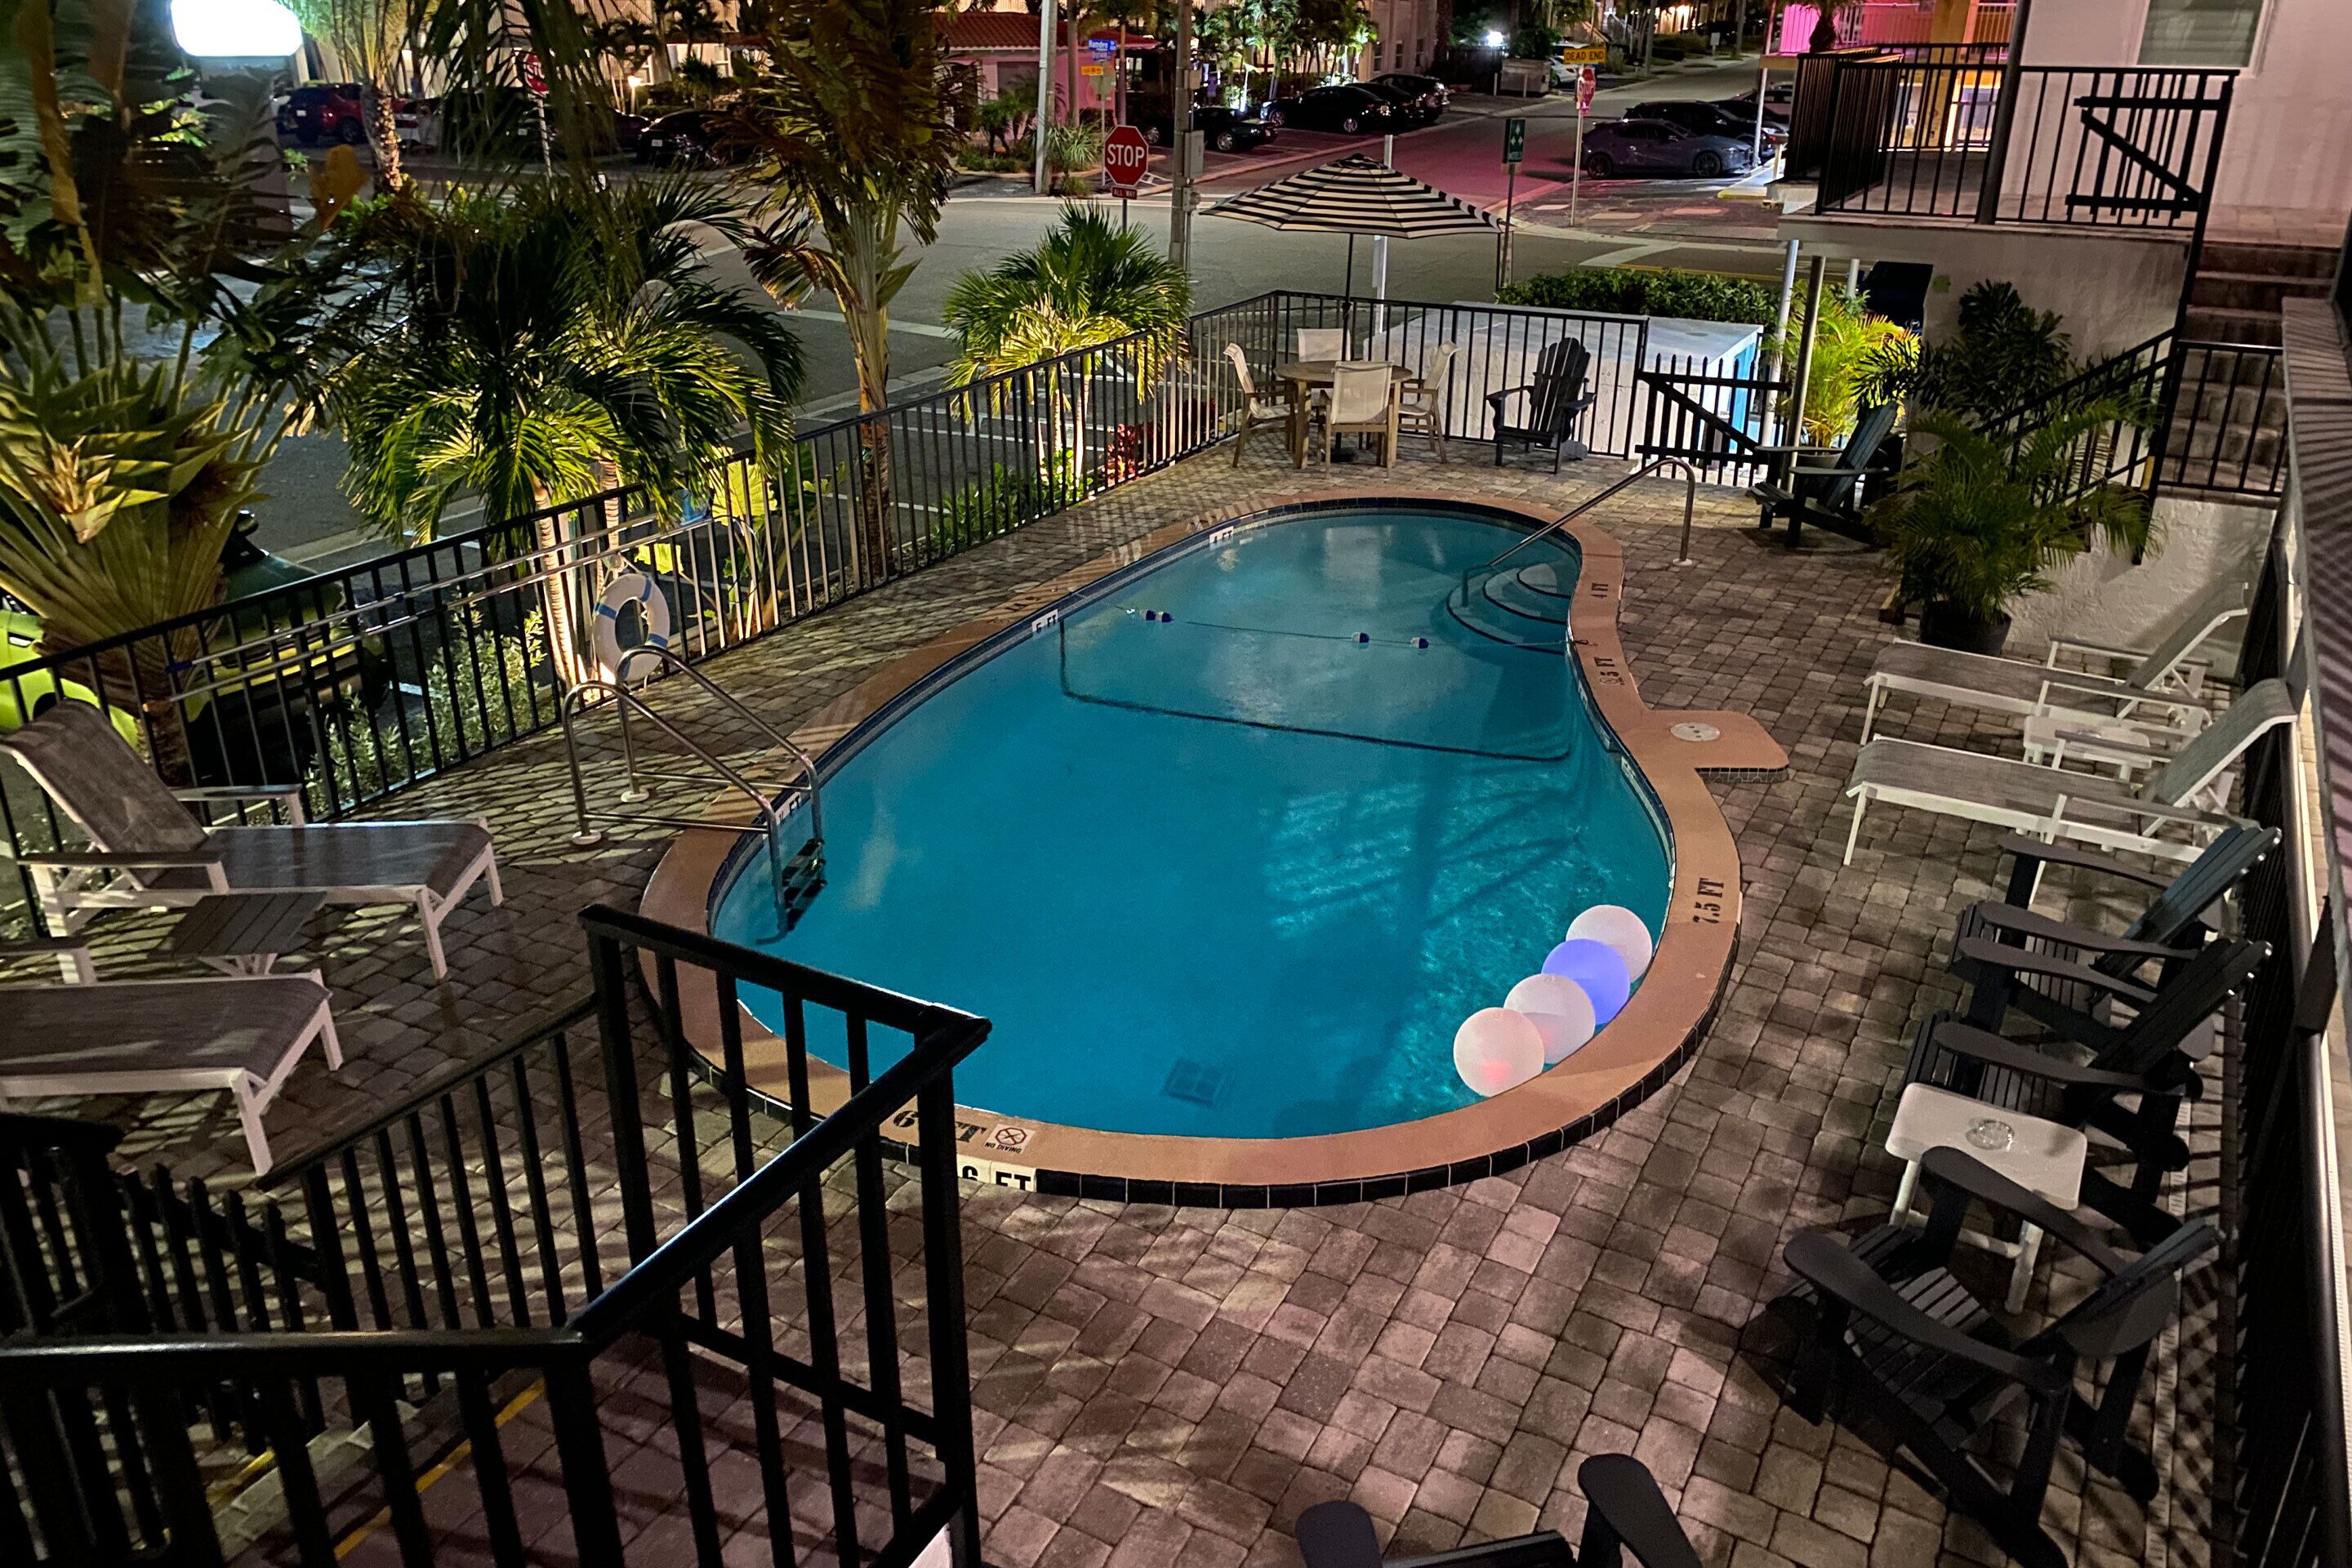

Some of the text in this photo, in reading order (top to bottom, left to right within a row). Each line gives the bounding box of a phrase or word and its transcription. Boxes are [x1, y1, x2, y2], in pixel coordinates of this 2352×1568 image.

[1566, 51, 1604, 61] DEAD END
[1107, 144, 1145, 167] STOP
[1125, 189, 1136, 198] WAY
[1593, 657, 1615, 667] FT
[1697, 877, 1724, 898] FT
[893, 1110, 920, 1128] 6
[996, 1144, 1022, 1154] DIVING
[996, 1170, 1031, 1192] FT
